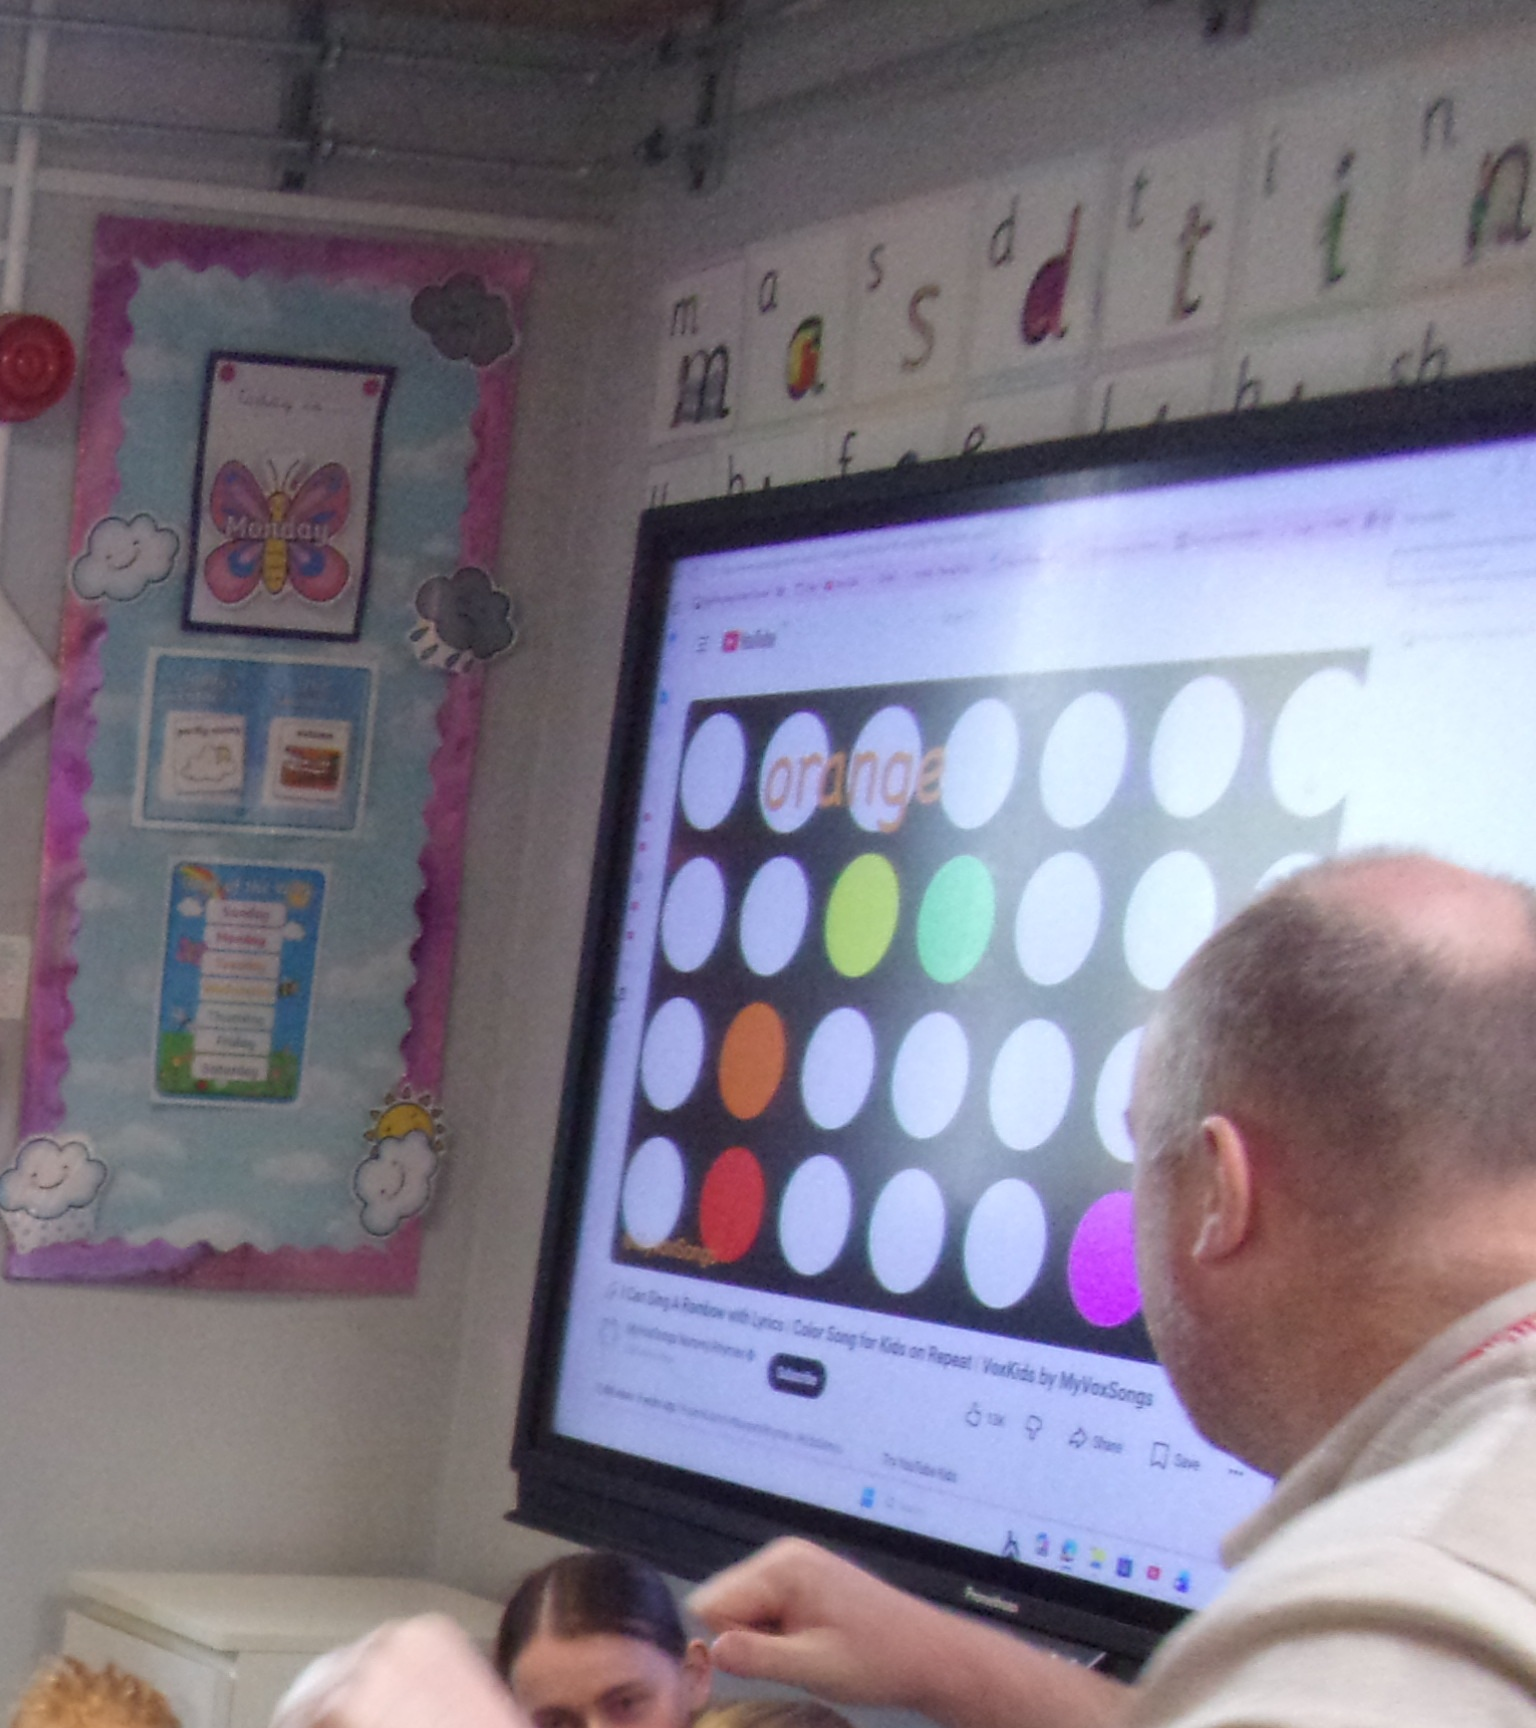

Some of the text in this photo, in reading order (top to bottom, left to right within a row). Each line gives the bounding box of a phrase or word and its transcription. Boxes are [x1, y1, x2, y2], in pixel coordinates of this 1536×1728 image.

[226, 515, 330, 546] Monday
[764, 745, 946, 834] orange
[880, 1336, 906, 1356] Kids
[928, 1345, 972, 1369] Repeat
[983, 1358, 1036, 1383] VoxKids
[1039, 1367, 1057, 1390] by
[1059, 1371, 1155, 1409] MyVoxSongs
[1093, 1434, 1123, 1453] Share
[1174, 1453, 1201, 1471] Save
